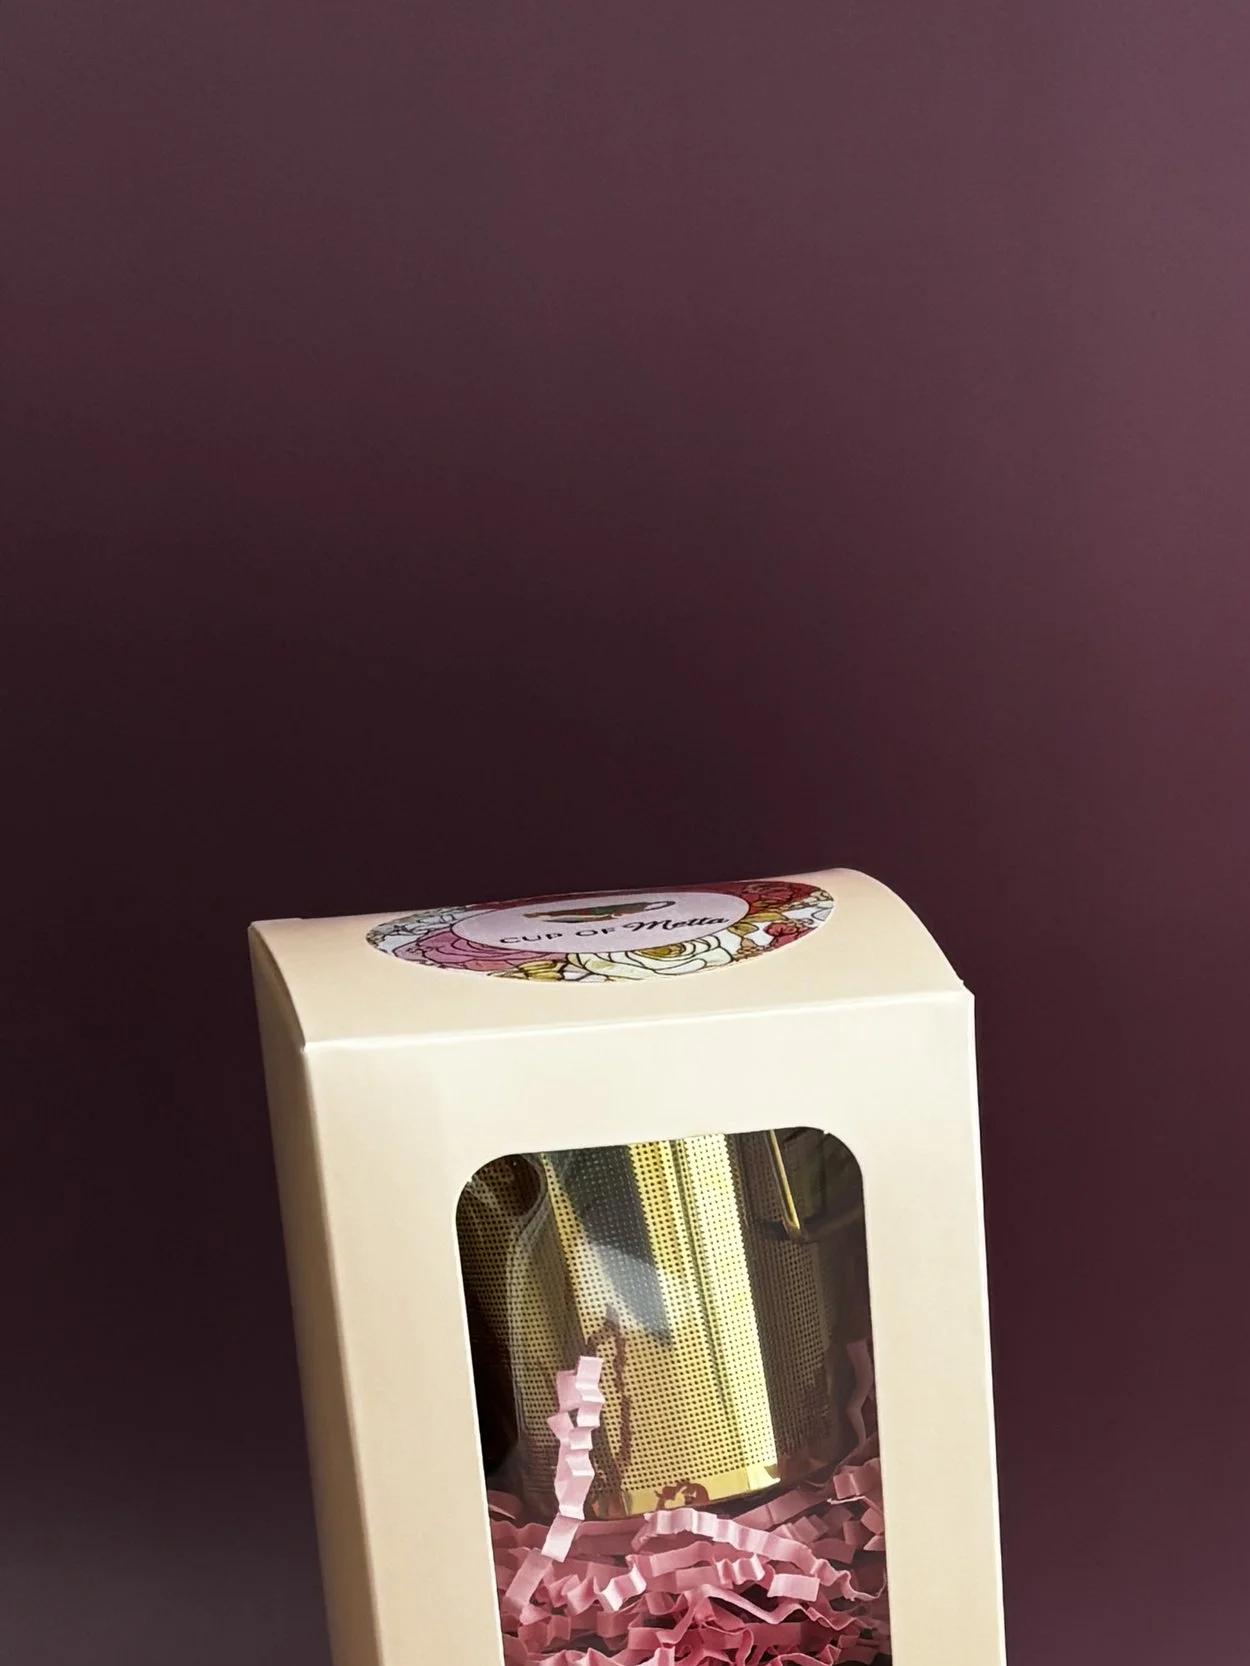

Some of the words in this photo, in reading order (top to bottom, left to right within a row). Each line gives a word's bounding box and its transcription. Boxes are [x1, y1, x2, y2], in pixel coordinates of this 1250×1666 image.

[500, 932, 563, 945] CUP
[575, 927, 615, 938] OF
[622, 916, 730, 932] Metta
